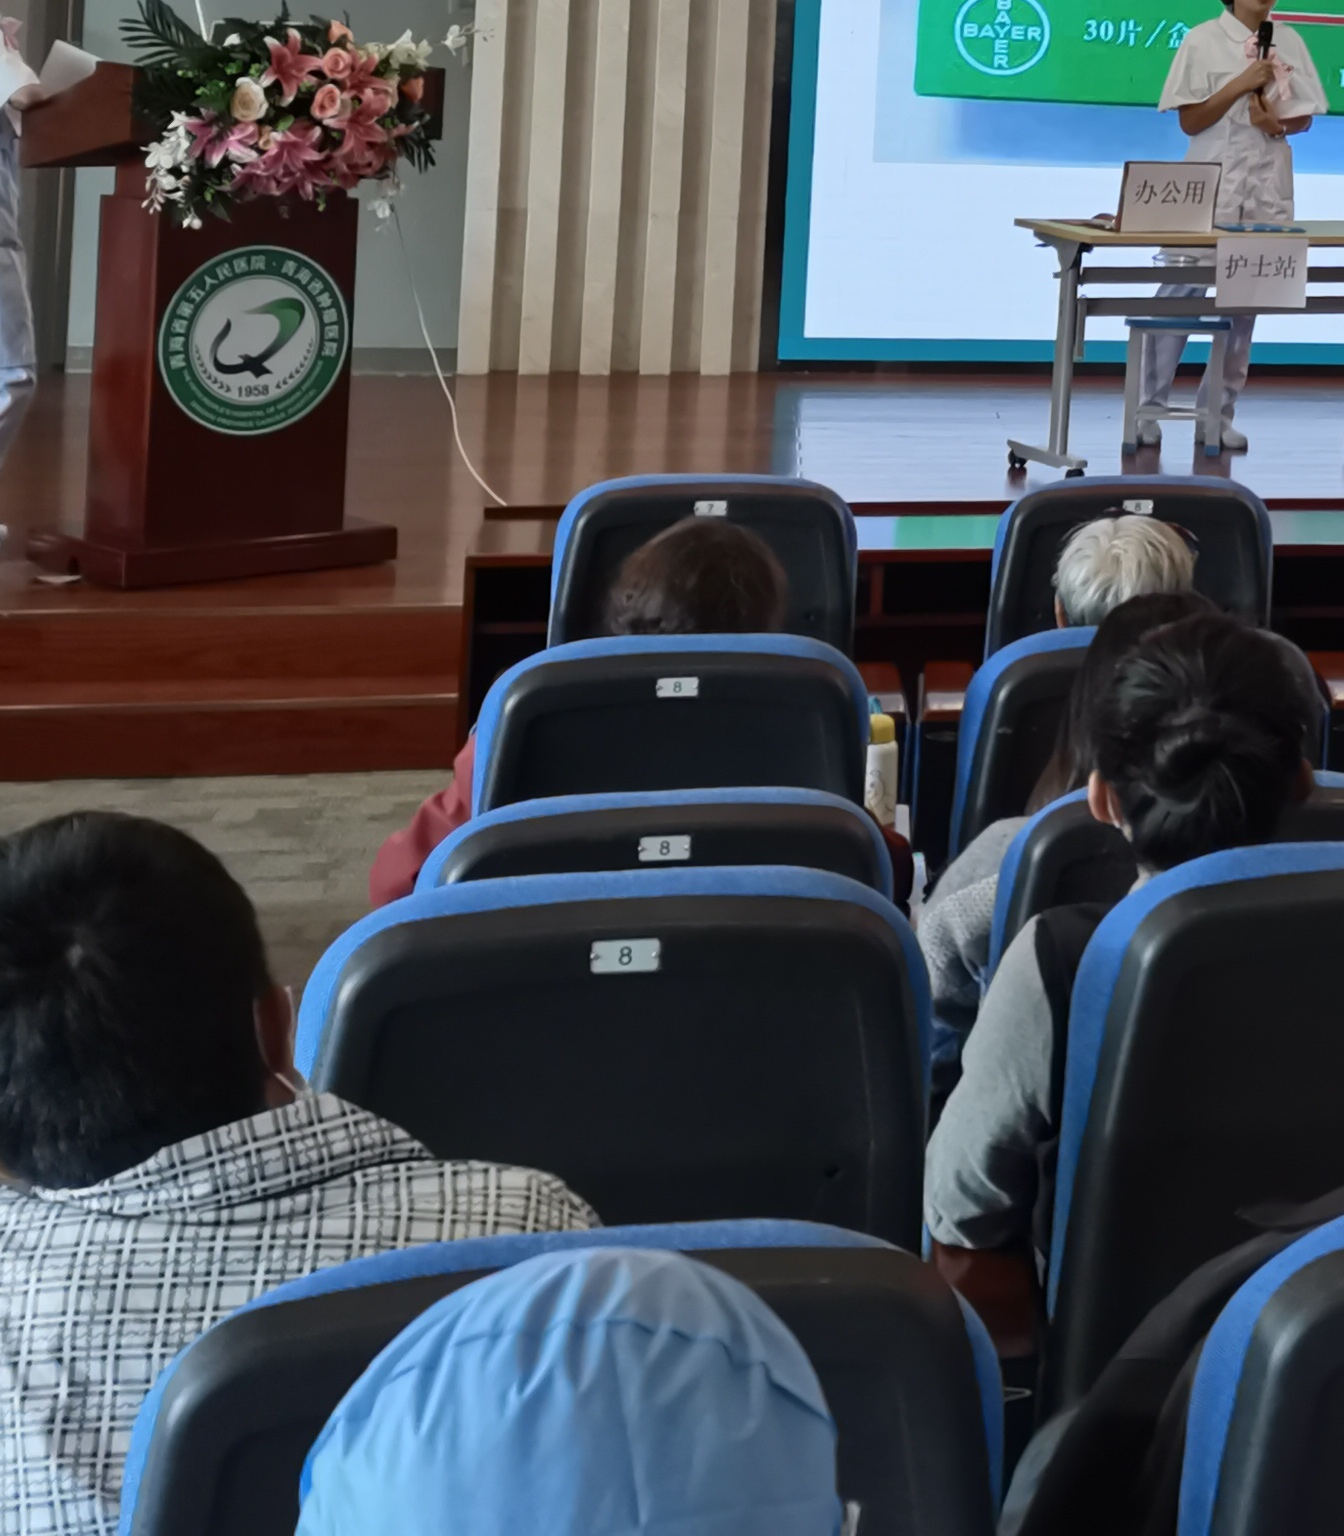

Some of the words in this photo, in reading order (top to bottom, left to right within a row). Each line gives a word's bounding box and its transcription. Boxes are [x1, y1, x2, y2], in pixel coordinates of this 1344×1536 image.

[962, 22, 1042, 41] BAYER
[1135, 179, 1206, 205] 办公用
[1225, 254, 1297, 280] 护士站
[672, 680, 683, 693] 8
[659, 840, 671, 856] 8
[617, 945, 634, 966] 8
